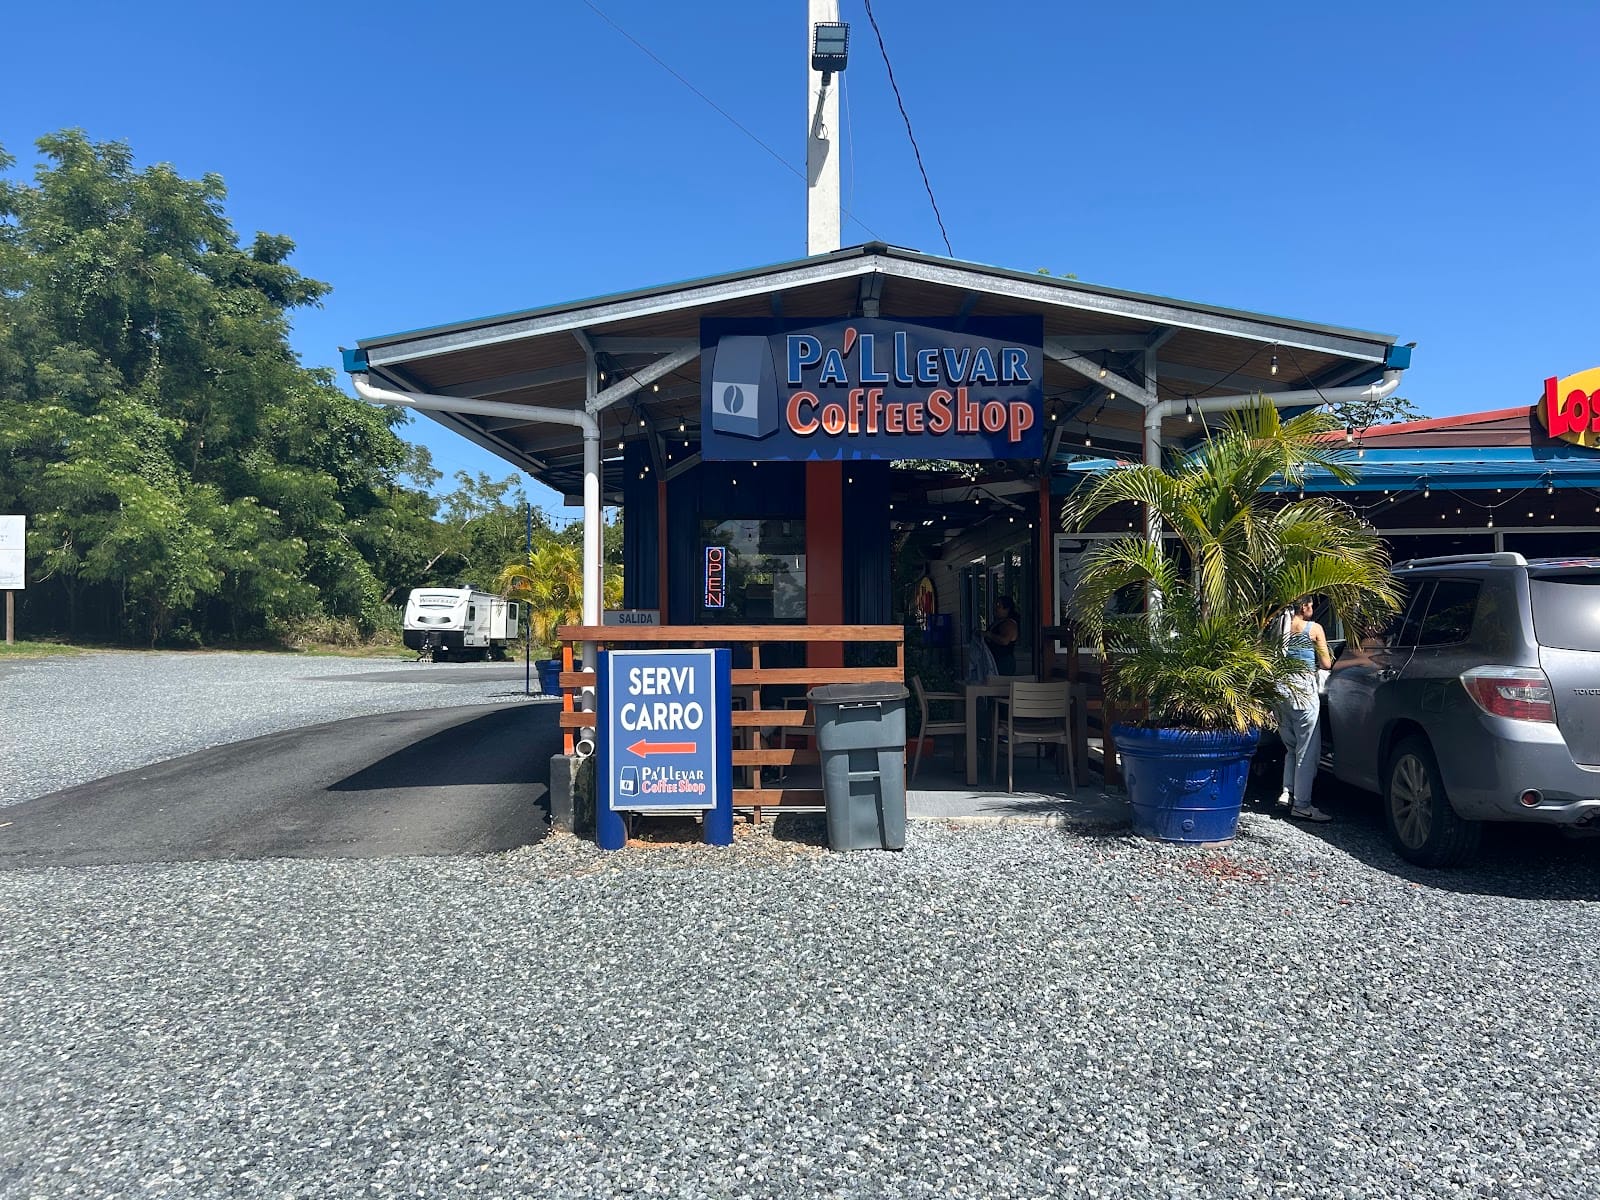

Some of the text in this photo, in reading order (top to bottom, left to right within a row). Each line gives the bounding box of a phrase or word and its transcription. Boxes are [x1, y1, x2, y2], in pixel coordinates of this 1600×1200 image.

[708, 548, 722, 606] OPEN
[618, 613, 653, 624] SALIDA
[628, 666, 695, 696] SERVI
[620, 702, 704, 731] CARRO
